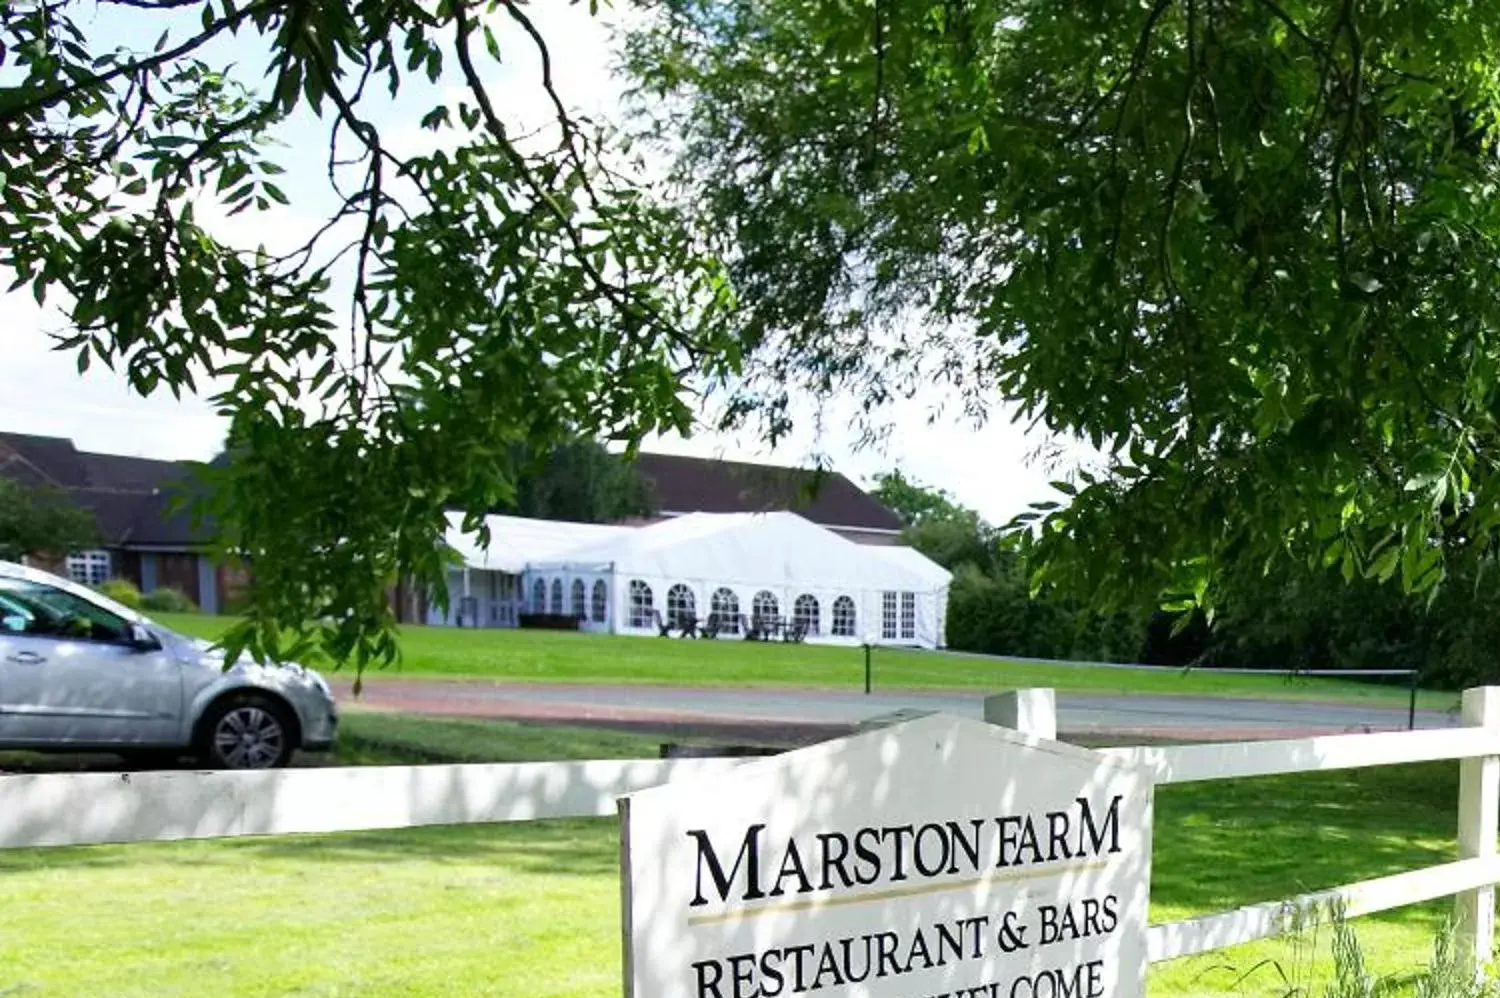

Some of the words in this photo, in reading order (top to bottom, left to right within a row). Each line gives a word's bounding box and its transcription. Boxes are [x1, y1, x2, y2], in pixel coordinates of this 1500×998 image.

[688, 819, 985, 906] MARSTON
[995, 795, 1123, 868] FARM
[997, 911, 1030, 953] &
[1038, 895, 1119, 946] BARS
